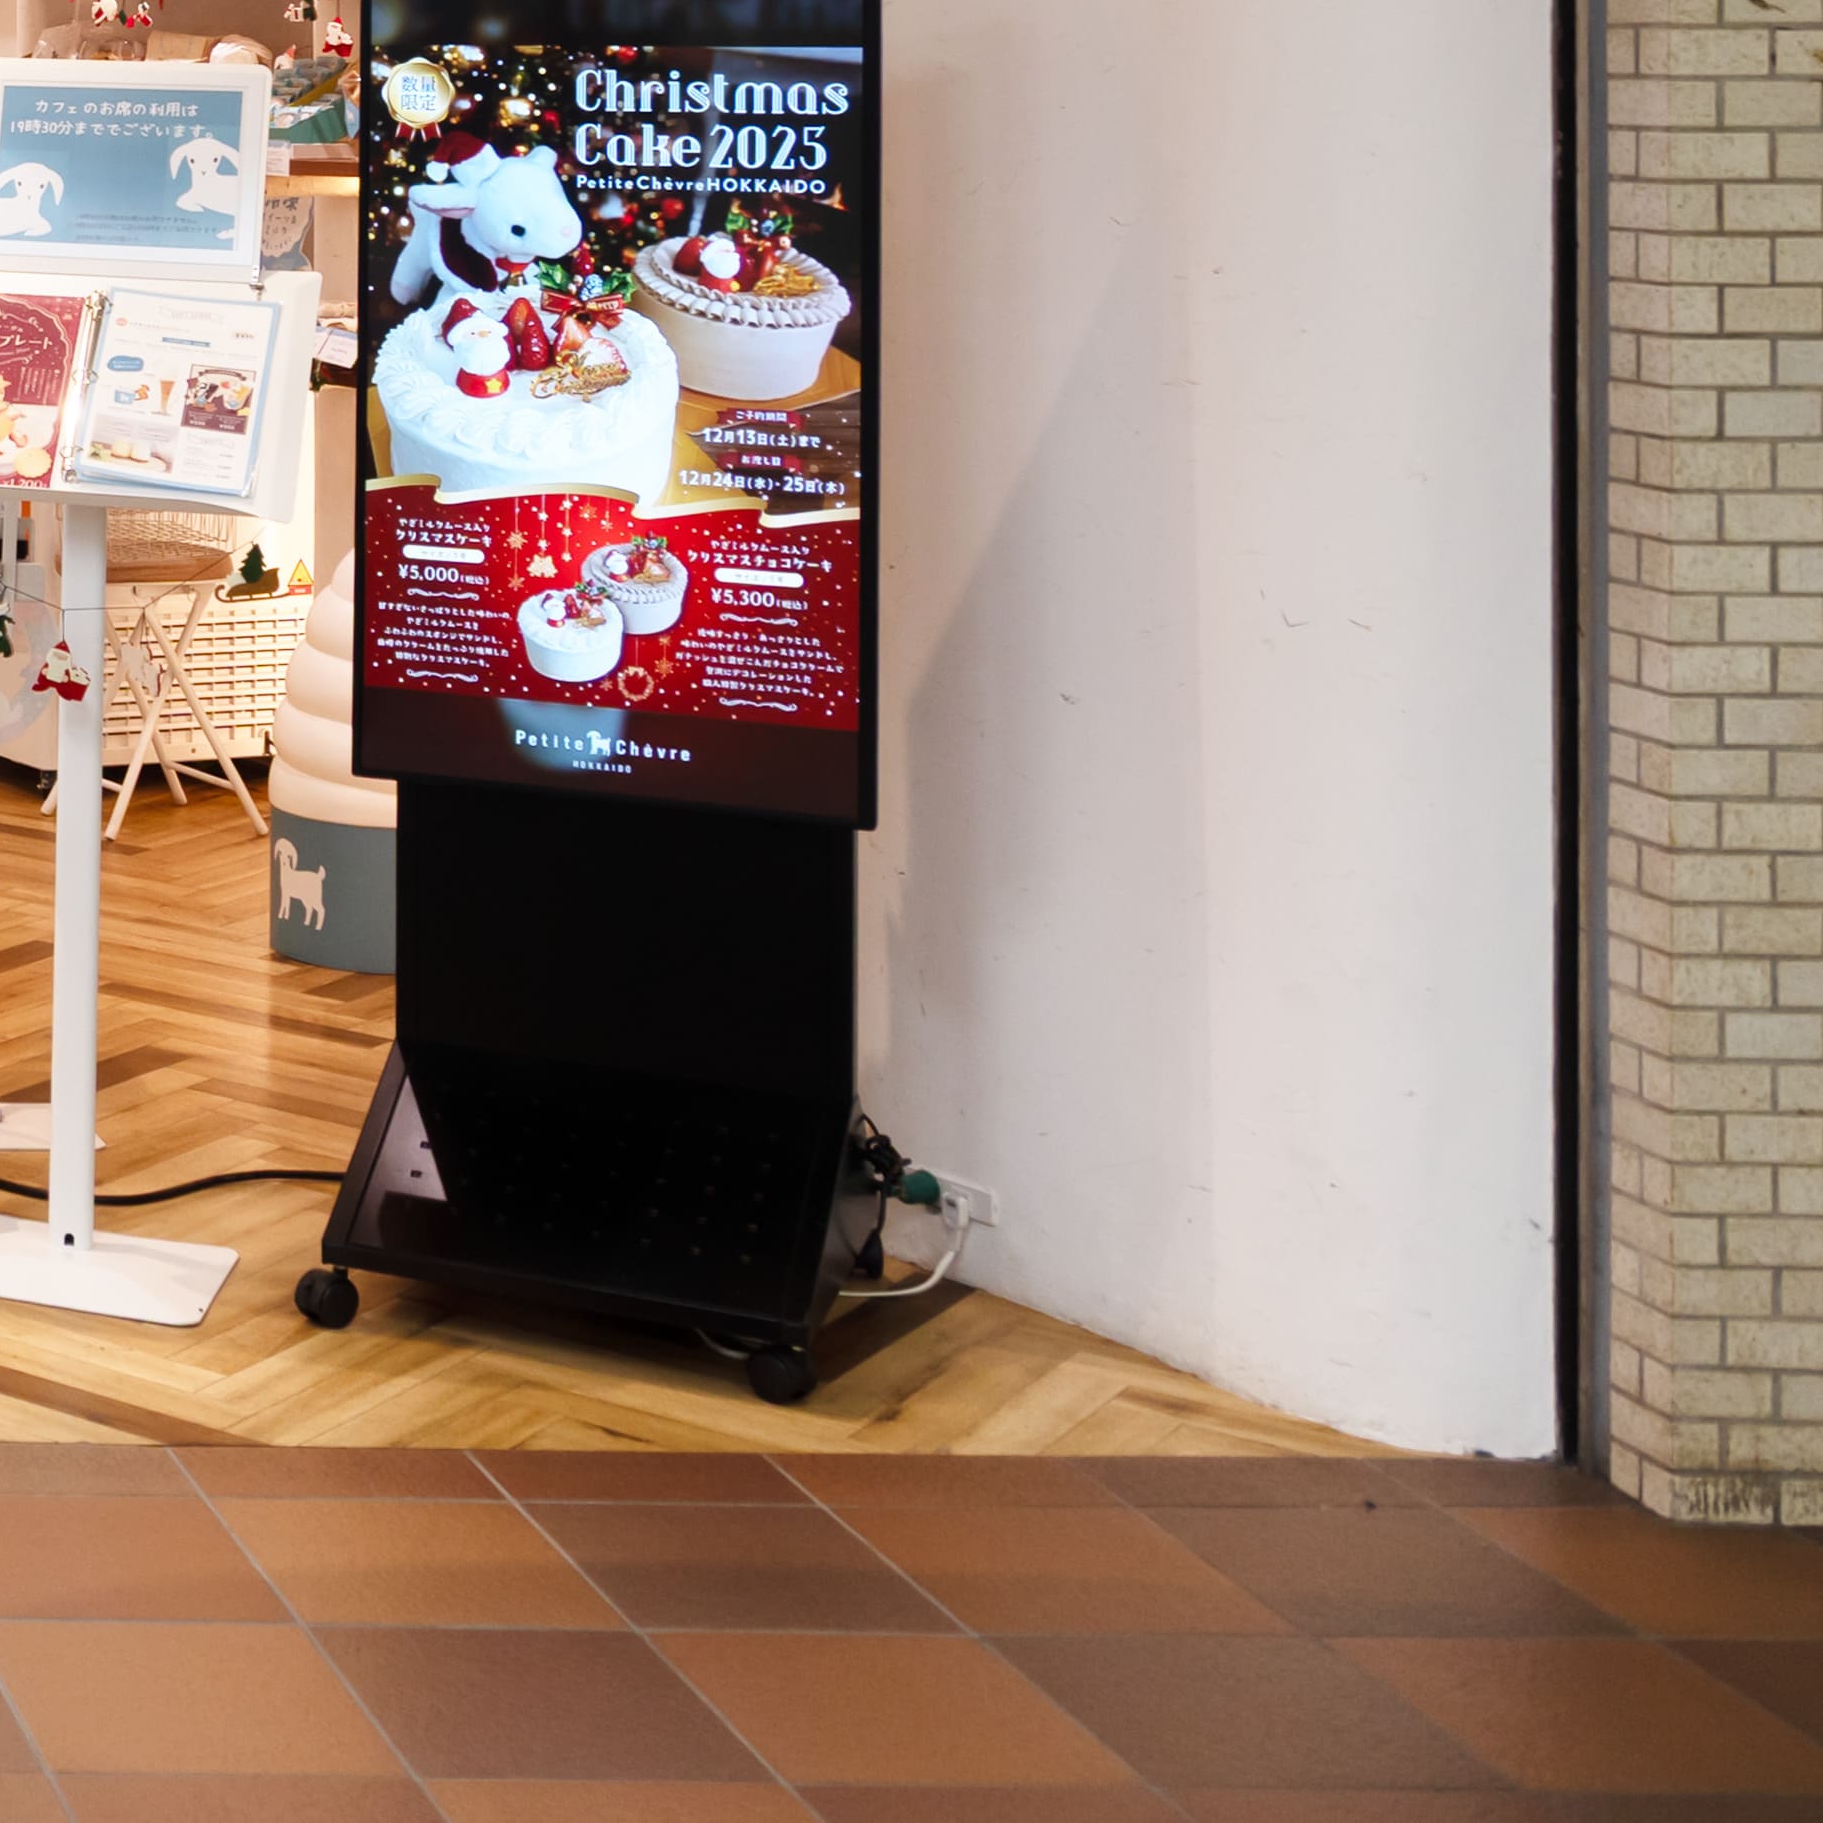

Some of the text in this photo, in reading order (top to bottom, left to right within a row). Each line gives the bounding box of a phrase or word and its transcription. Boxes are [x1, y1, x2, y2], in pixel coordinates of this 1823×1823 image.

[401, 75, 436, 94] 数量
[574, 68, 850, 115] Christmas
[35, 100, 199, 118] カフェのお席の利用は
[400, 93, 437, 112] 限定
[575, 122, 828, 171] Cake 2025
[703, 427, 822, 449] 12月13日(土)まで
[396, 529, 492, 548] クリスマスケーキ
[687, 548, 832, 573] クリスマスチョコケーキ
[515, 729, 691, 762] Petite Chèvre
[572, 760, 633, 774] HOKKAIDO
